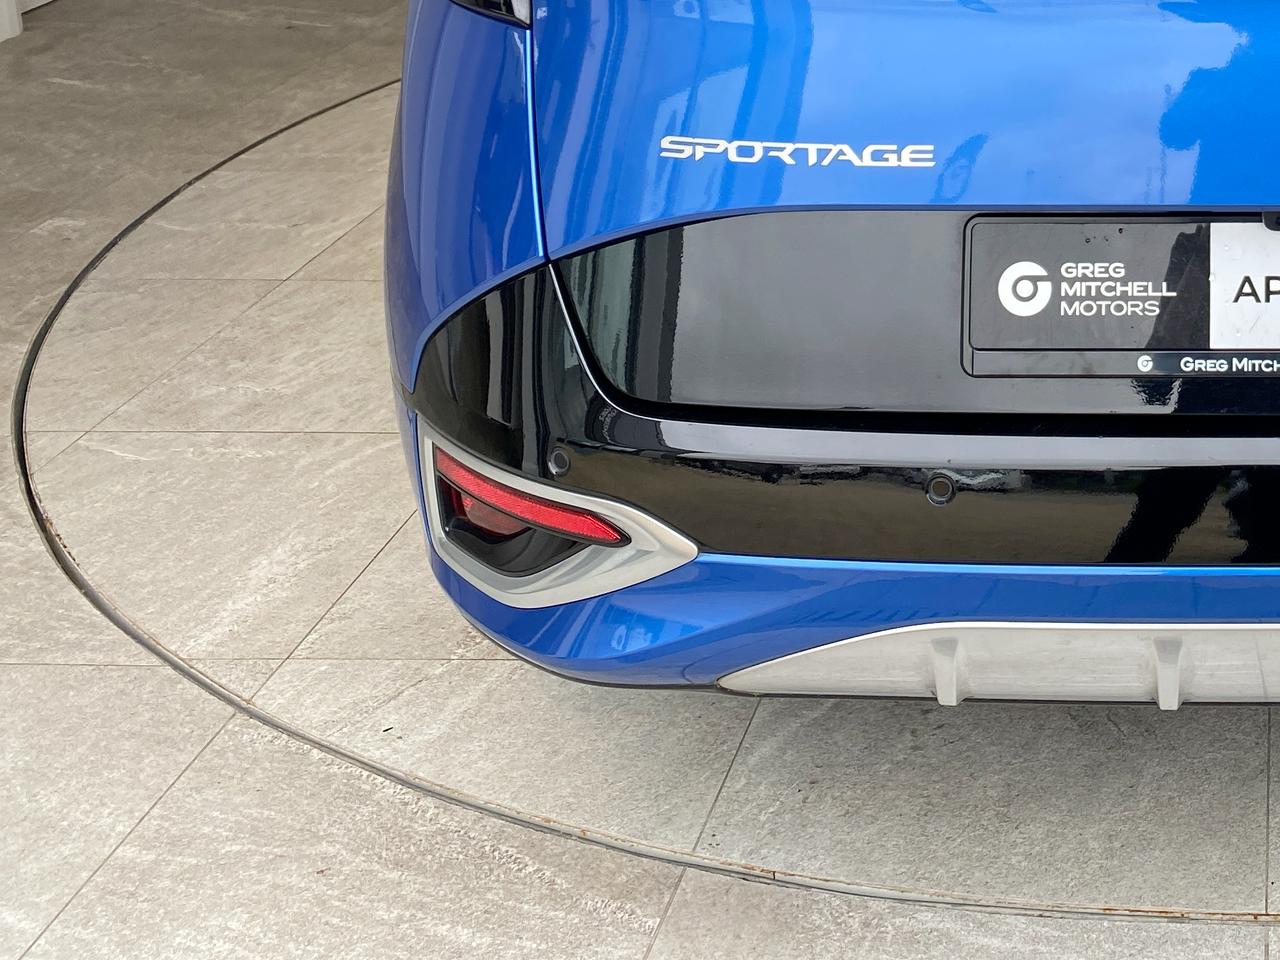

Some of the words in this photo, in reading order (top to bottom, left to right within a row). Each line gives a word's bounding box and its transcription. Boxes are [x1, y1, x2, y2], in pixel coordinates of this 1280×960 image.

[660, 135, 936, 167] SPORTAGE
[1060, 262, 1126, 278] GREG
[1060, 281, 1177, 297] MITCHELL
[1060, 300, 1160, 316] MOTORS
